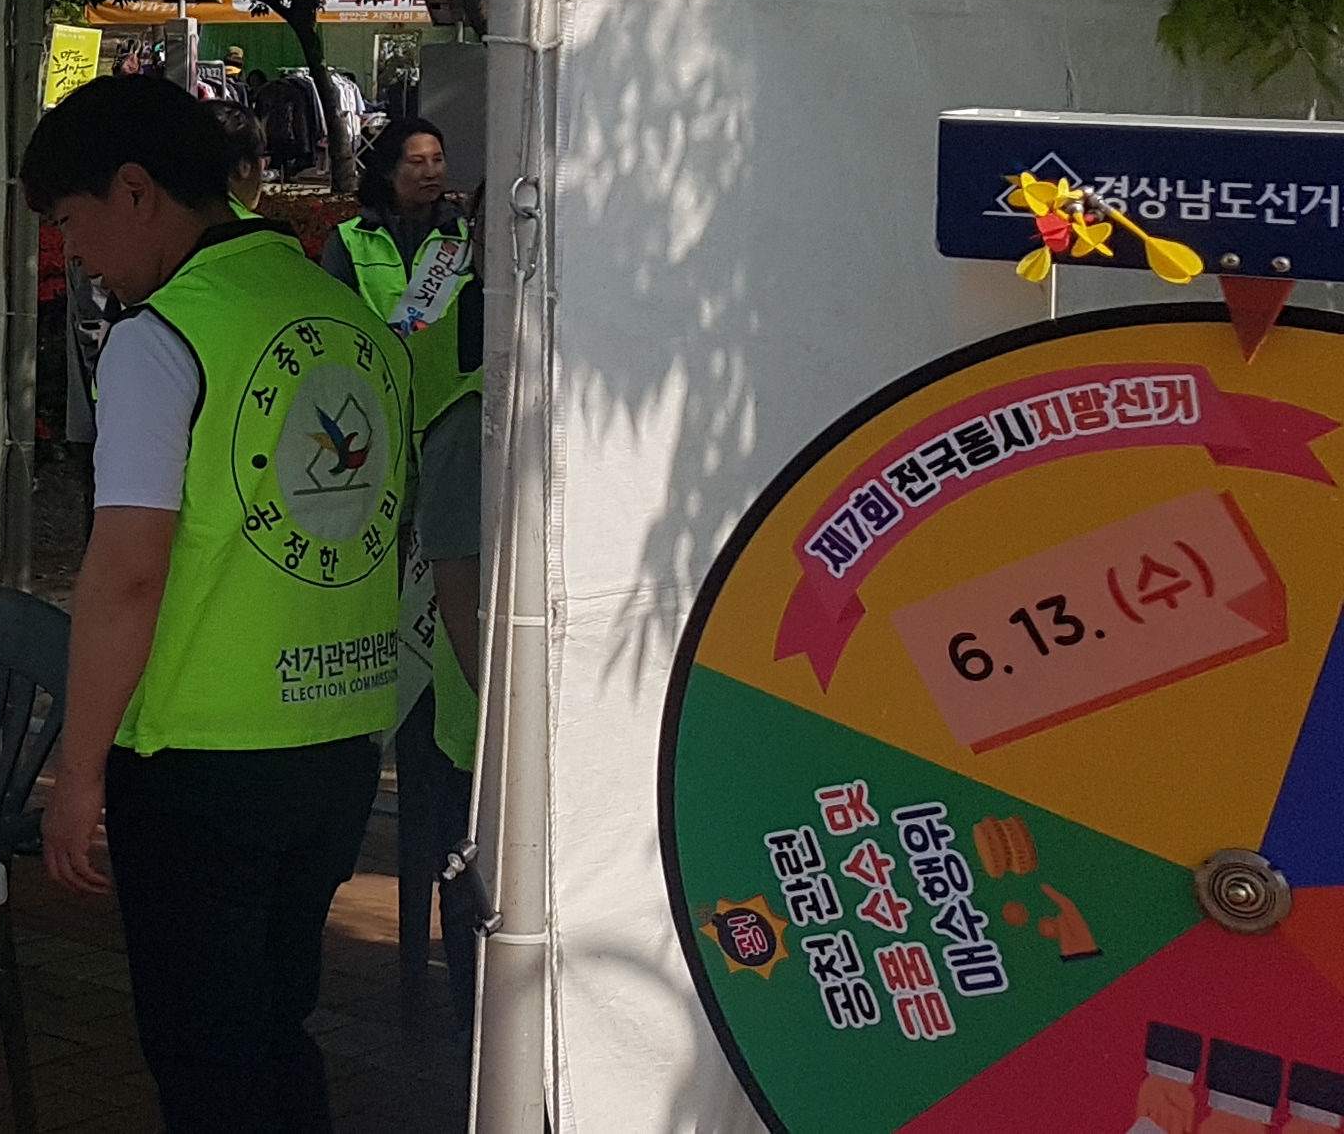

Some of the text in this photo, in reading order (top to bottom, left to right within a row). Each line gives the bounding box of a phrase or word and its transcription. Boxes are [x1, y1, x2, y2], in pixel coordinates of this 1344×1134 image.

[1092, 174, 1344, 229] 경상남도선거
[251, 322, 325, 417] 소중한
[811, 375, 1200, 575] 제7회 전국동시지방선거
[244, 500, 339, 583] 공정한
[1009, 594, 1108, 657] 13.
[1106, 539, 1215, 625] (수)
[275, 628, 399, 684] 선거관리위원회
[281, 680, 347, 703] ELECTION
[768, 829, 877, 1026] 공천 관련
[818, 783, 954, 1038] 금품 수수 및
[895, 805, 1005, 993] 매수행위
